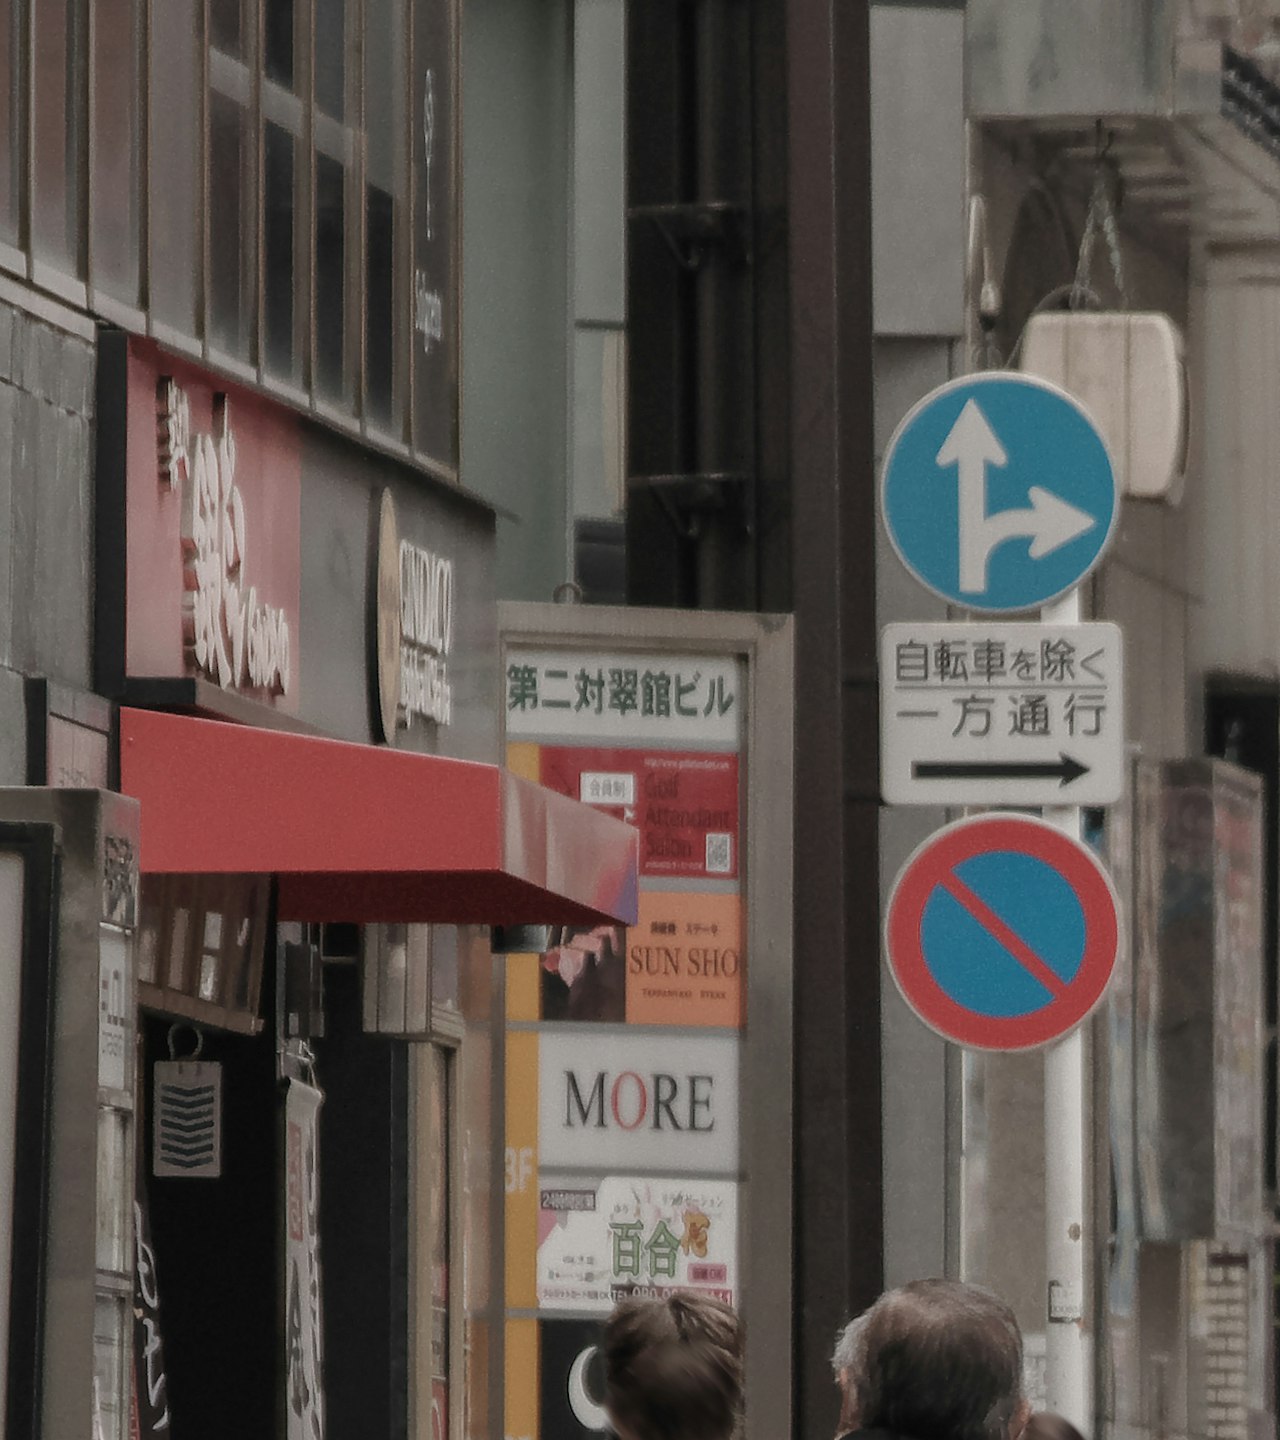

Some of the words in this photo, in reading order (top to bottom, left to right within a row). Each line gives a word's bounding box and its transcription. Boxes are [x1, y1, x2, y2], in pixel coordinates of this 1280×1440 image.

[895, 638, 1106, 682] 自転車を除く
[507, 663, 735, 718] 第二対翠館ビル
[895, 694, 1108, 737] 一方通行
[629, 945, 680, 976] SUN
[687, 947, 739, 978] SHO
[562, 1069, 715, 1132] MORE
[609, 1219, 681, 1278] 百合
